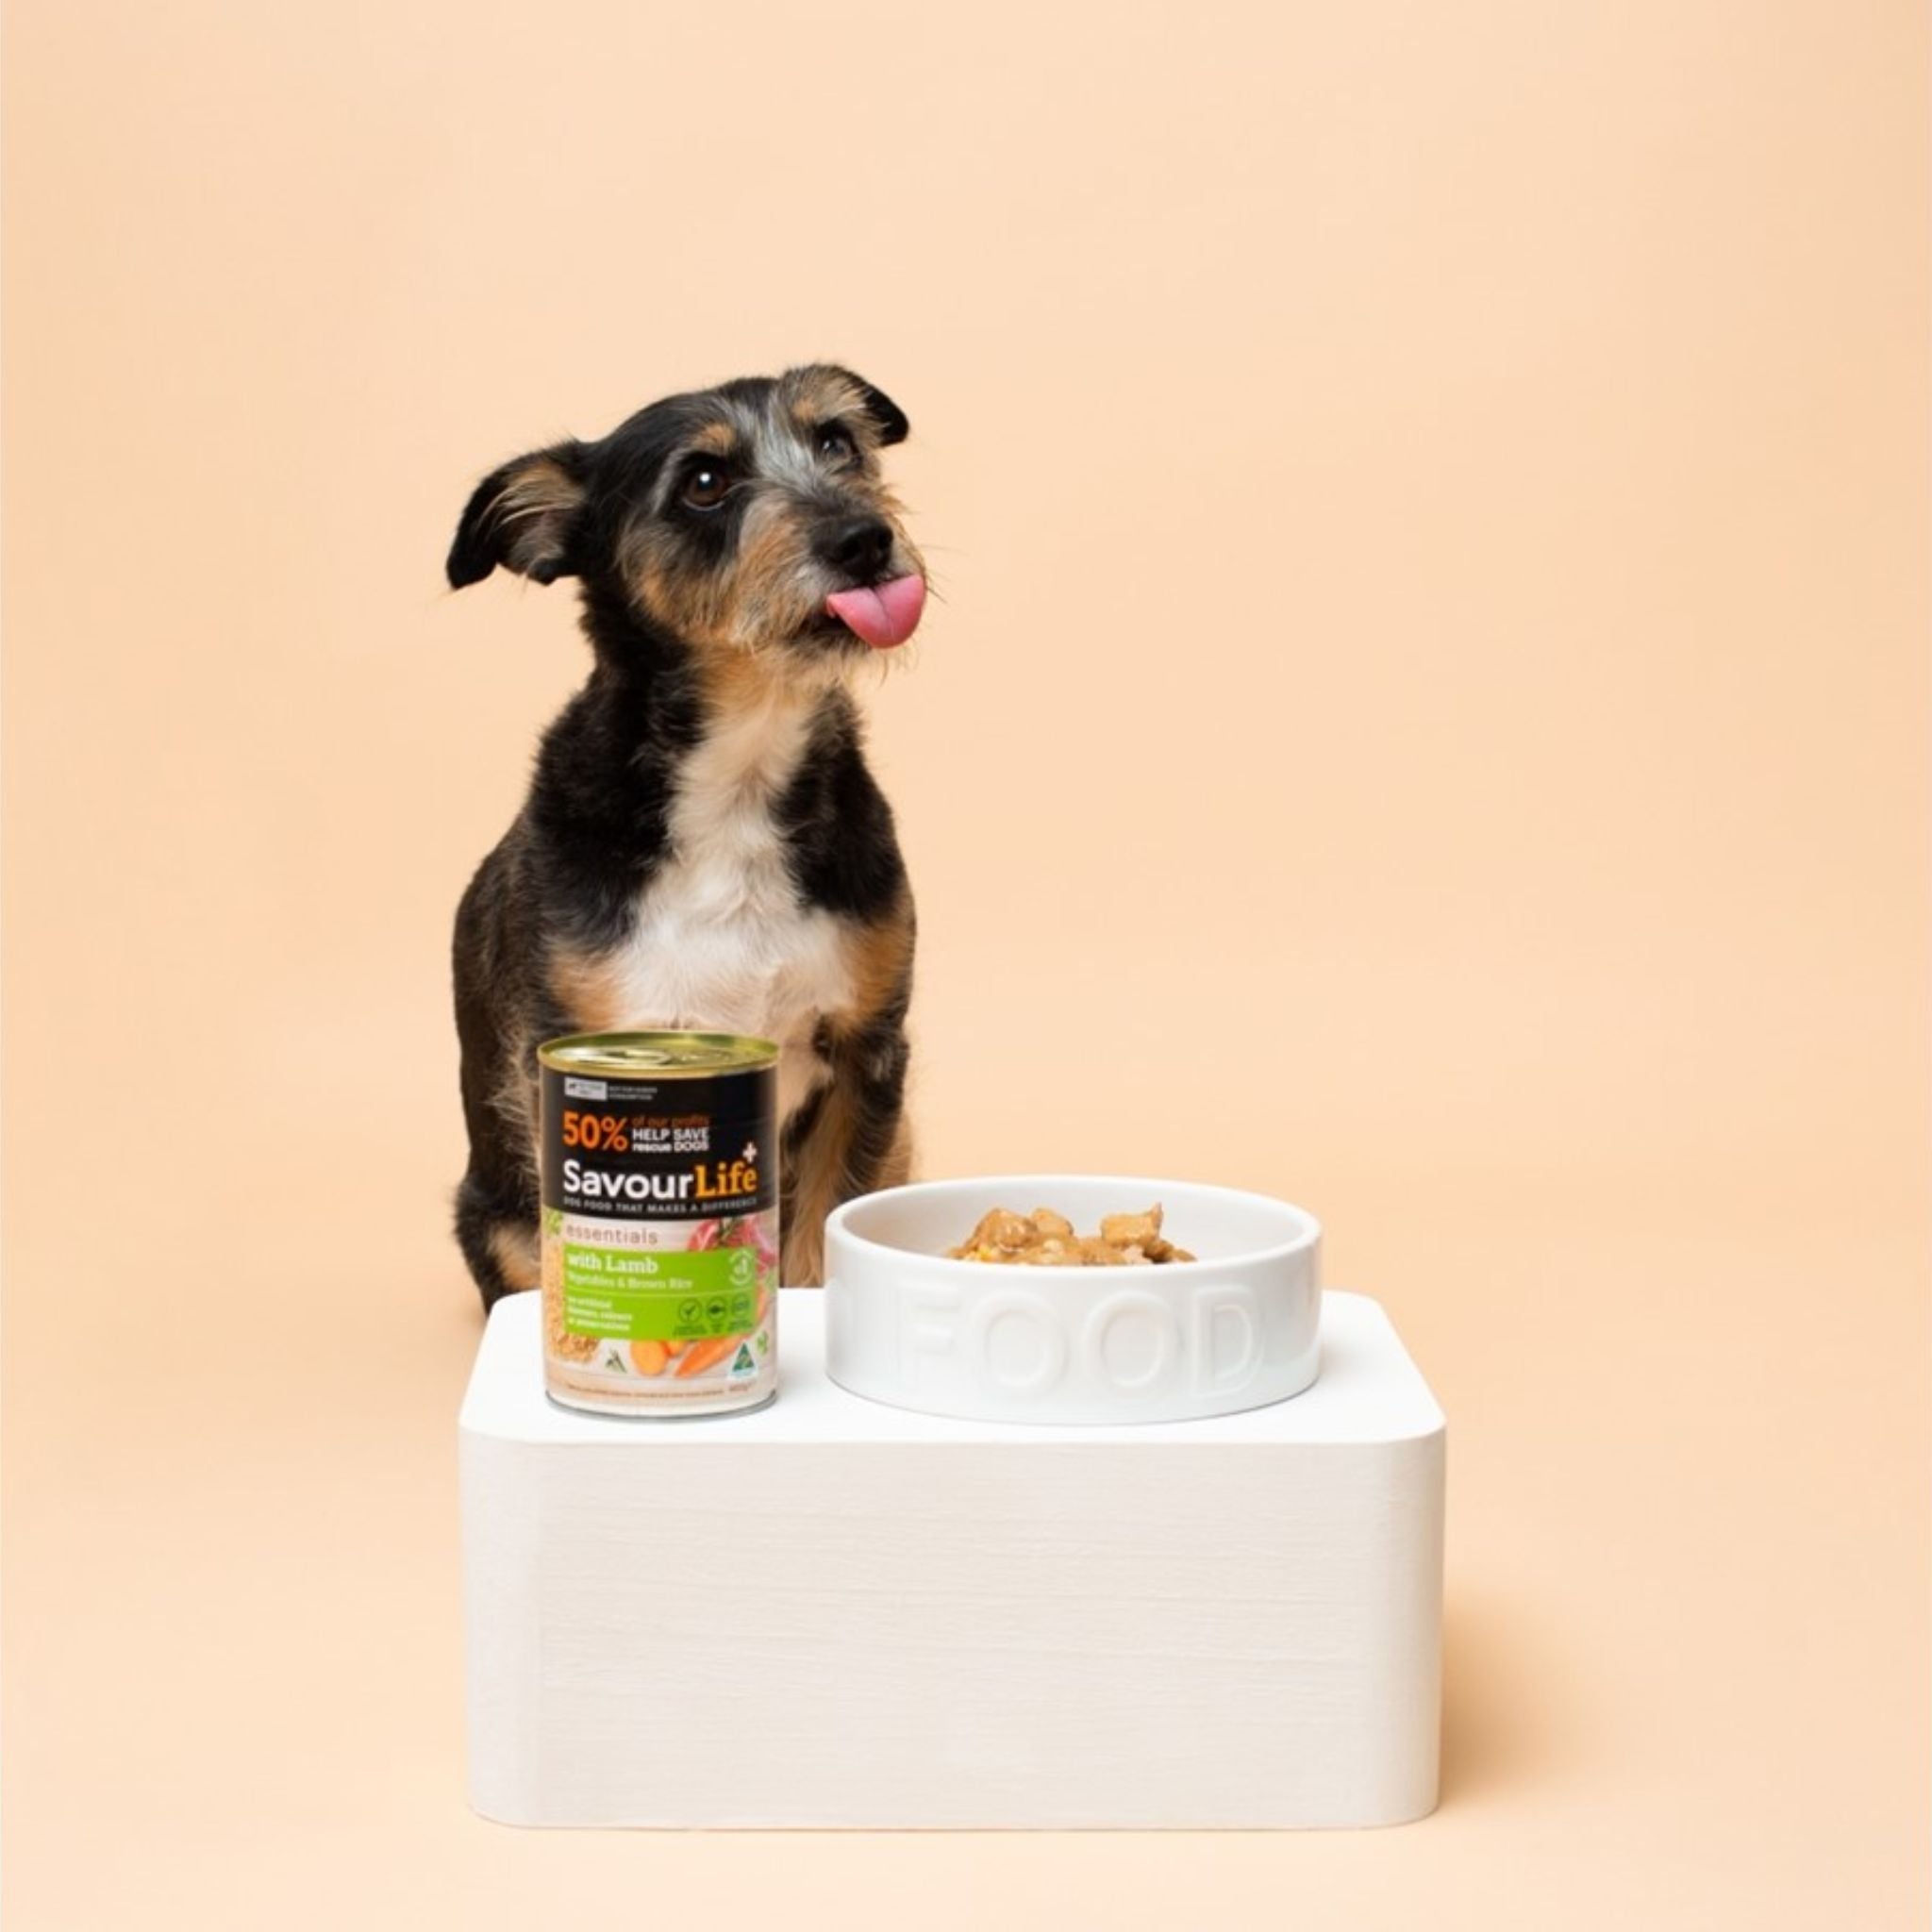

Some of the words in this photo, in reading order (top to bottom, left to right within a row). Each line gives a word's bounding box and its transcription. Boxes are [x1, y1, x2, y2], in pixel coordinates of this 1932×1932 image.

[562, 1110, 629, 1152] 50%
[633, 1128, 671, 1141] HELP
[674, 1126, 709, 1141] SAVE
[633, 1141, 673, 1152] rescue
[674, 1141, 709, 1152] DOGS
[584, 1199, 612, 1210] FOOD
[616, 1203, 643, 1212] THAT
[647, 1203, 687, 1213] MAKES
[691, 1204, 698, 1212] A
[566, 1224, 658, 1244] essentials
[567, 1253, 602, 1271] with
[605, 1255, 658, 1274] Lamb
[898, 1282, 1266, 1403] FOOD
